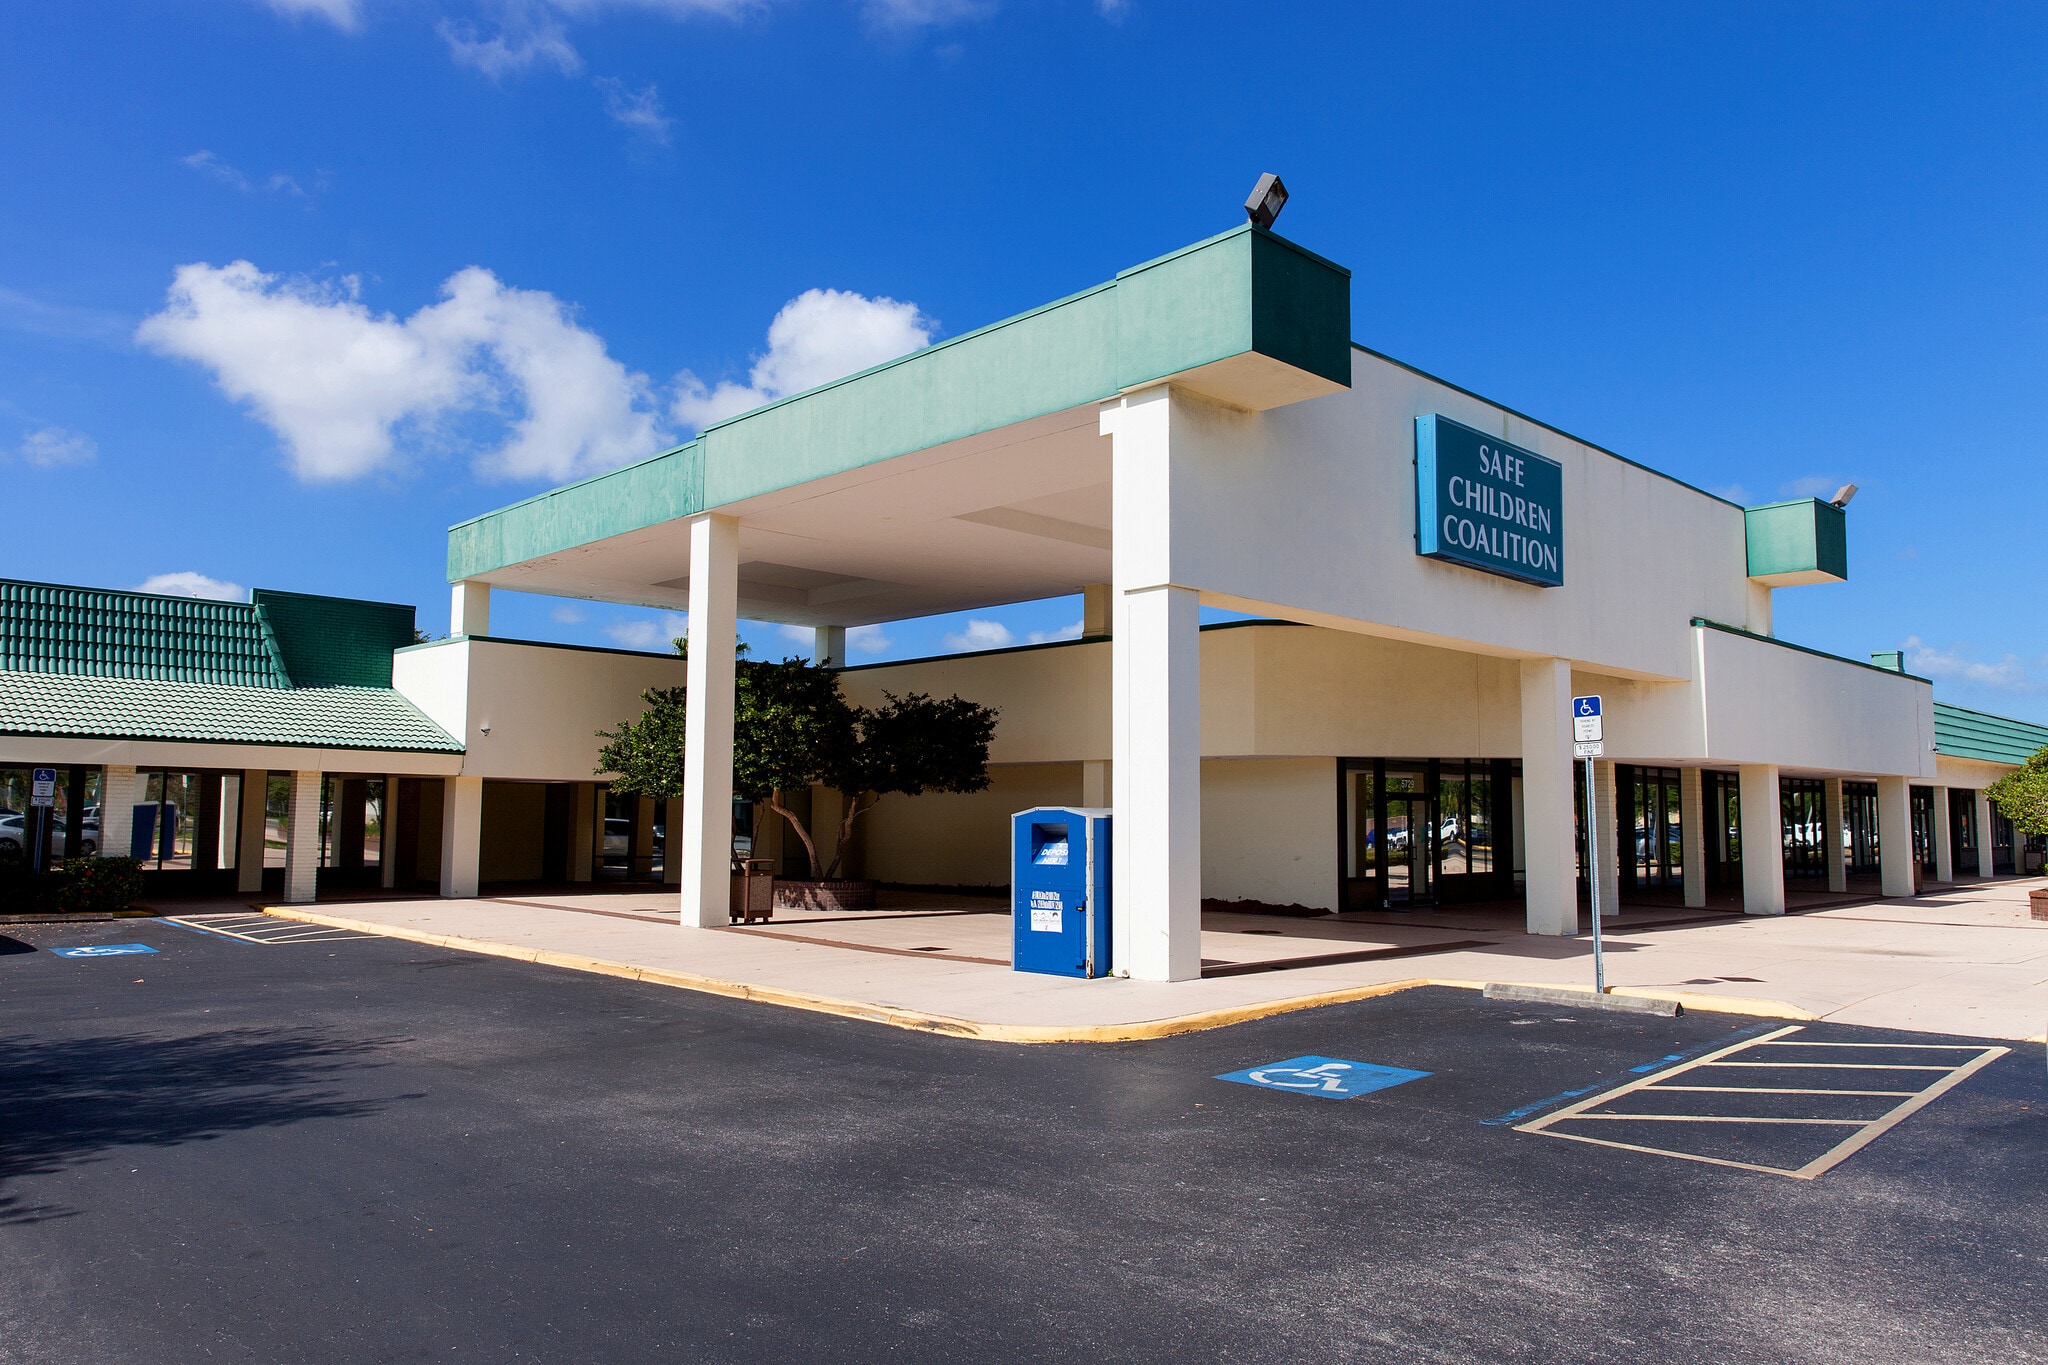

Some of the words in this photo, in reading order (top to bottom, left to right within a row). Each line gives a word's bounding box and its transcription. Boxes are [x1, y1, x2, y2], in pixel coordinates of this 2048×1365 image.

[1479, 444, 1525, 488] SAFE
[1448, 475, 1551, 534] CHILDREN
[1443, 514, 1557, 573] COALITION
[1401, 779, 1415, 789] 5729
